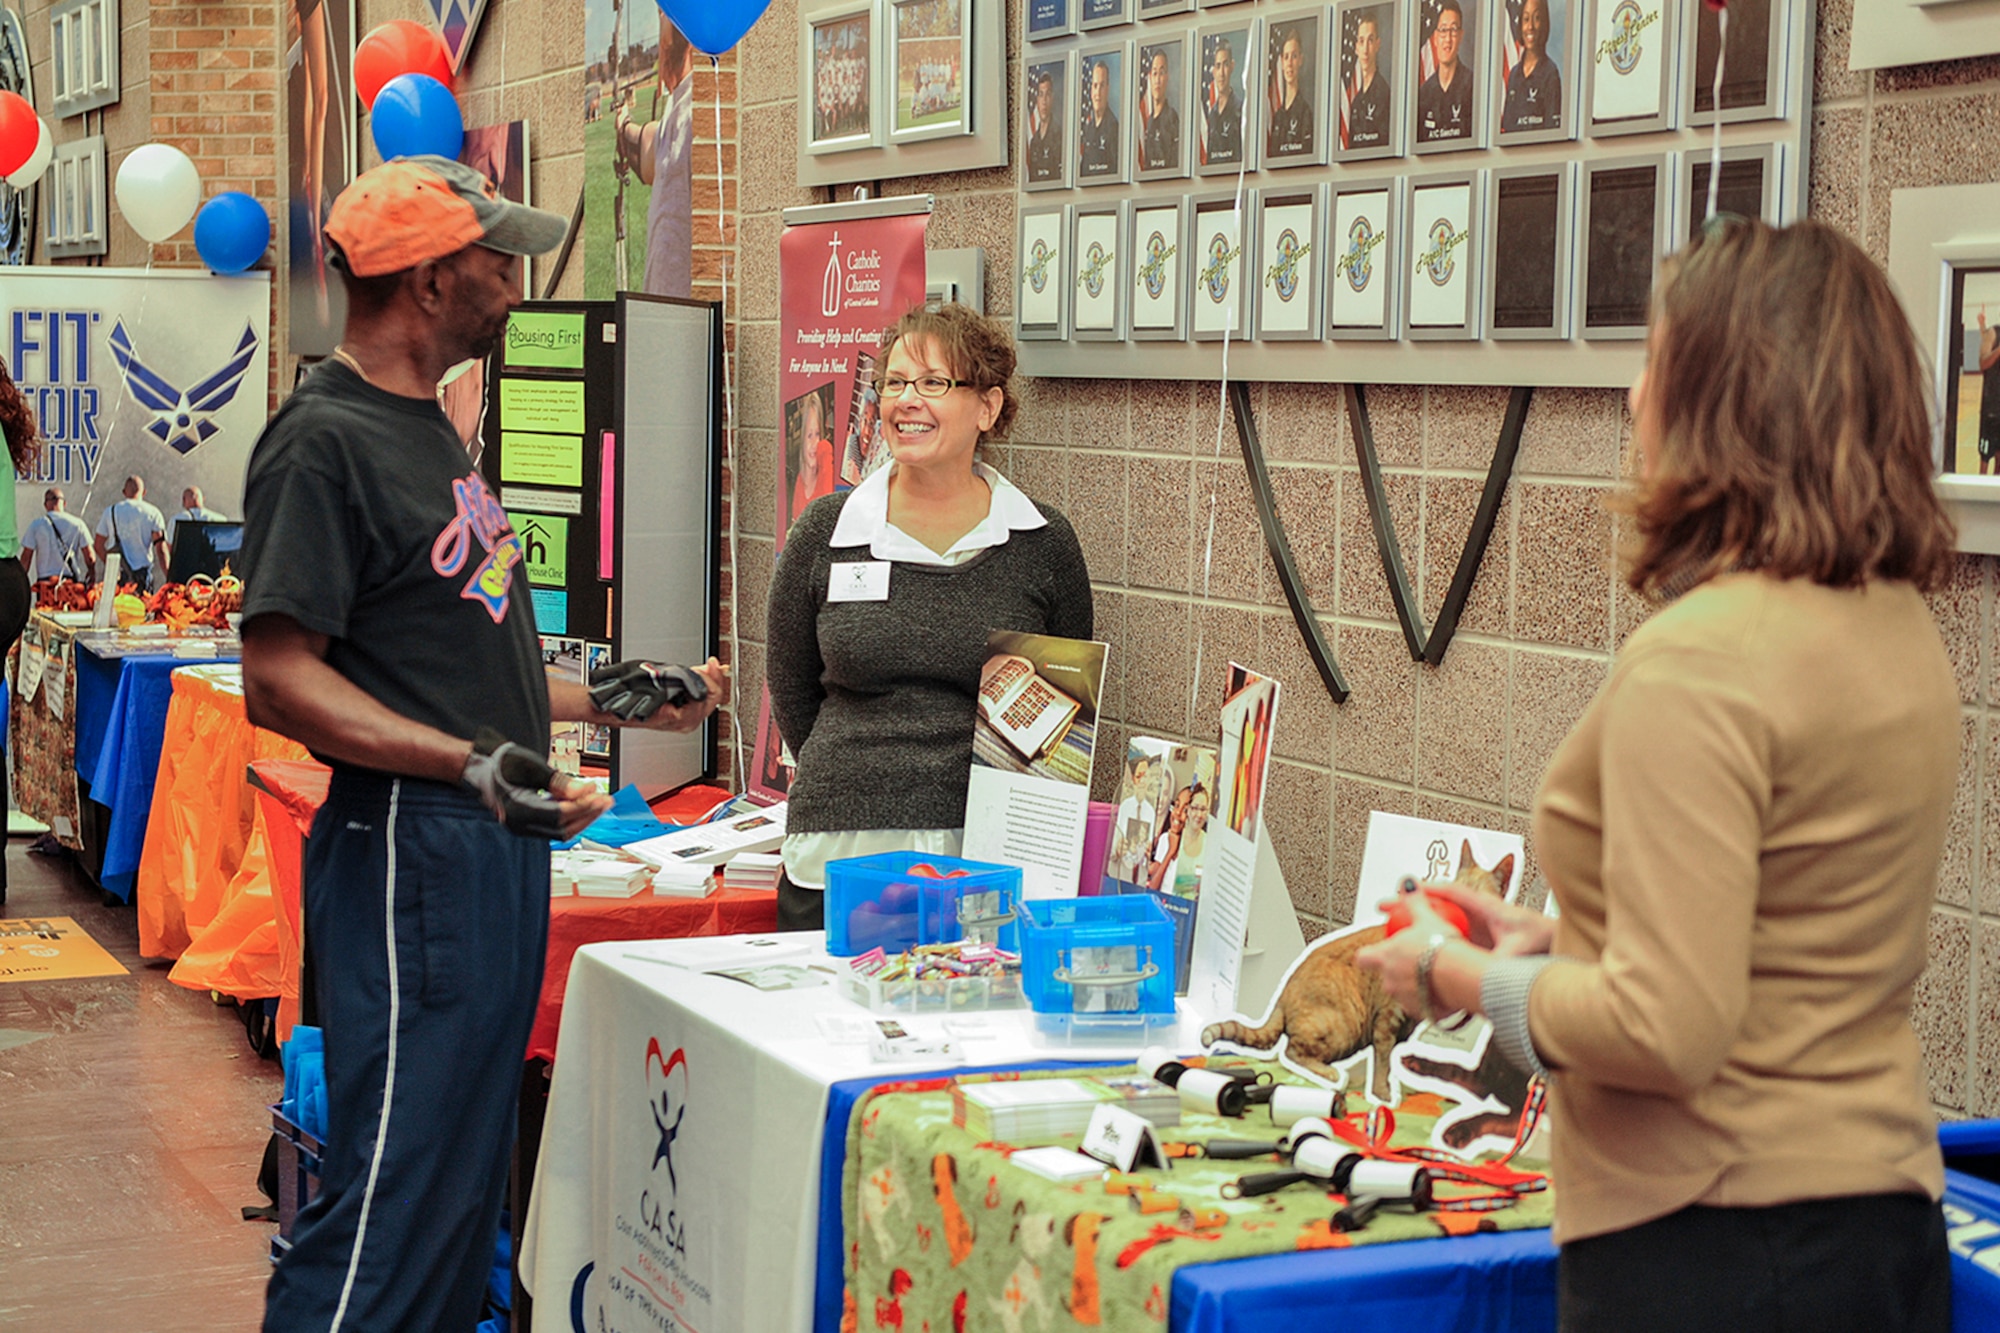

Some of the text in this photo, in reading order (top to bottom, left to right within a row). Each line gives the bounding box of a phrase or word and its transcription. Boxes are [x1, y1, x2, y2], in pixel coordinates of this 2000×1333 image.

[847, 250, 880, 270] Catholic
[845, 273, 880, 293] Charities
[508, 323, 581, 348] Housing First
[797, 329, 826, 348] Providing
[826, 328, 842, 348] Help
[842, 328, 855, 343] and
[855, 328, 881, 348] Creating
[11, 310, 101, 384] FIT
[789, 358, 848, 378] For Anyone In Need.
[528, 566, 564, 580] House Clinic
[641, 1188, 687, 1262] CASA
